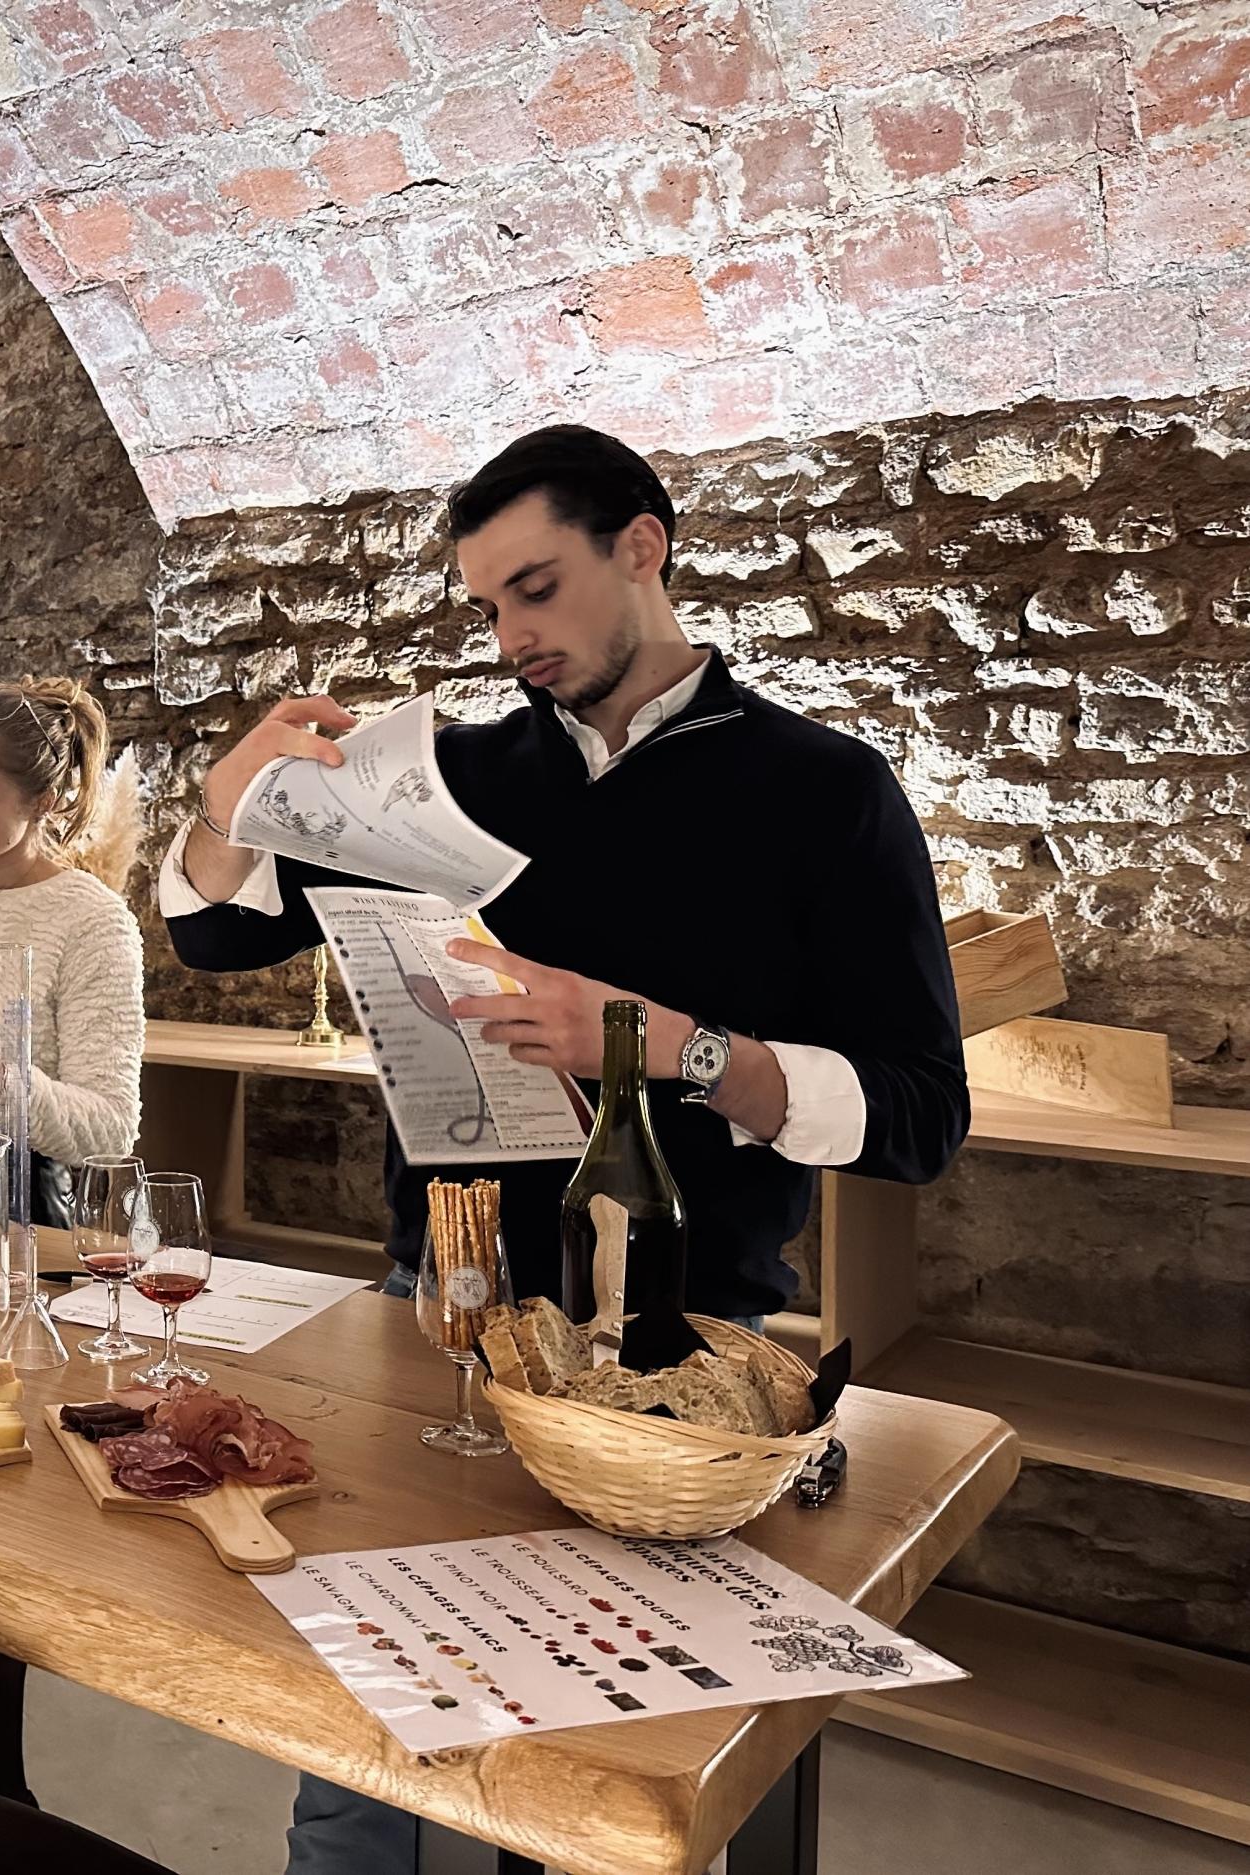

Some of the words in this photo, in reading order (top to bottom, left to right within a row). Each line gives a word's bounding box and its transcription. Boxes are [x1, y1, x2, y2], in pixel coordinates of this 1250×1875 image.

[302, 1565, 320, 1575] LE
[314, 1576, 366, 1619] SAVAGNIN
[345, 1561, 363, 1570] LE
[359, 1572, 431, 1629] CHARDONNAY
[430, 1552, 448, 1562] LE
[443, 1564, 480, 1588] PINOT
[476, 1590, 508, 1611] NOIR
[471, 1548, 490, 1558] LE
[486, 1559, 555, 1607] TROUSSEAU
[512, 1543, 531, 1553] LE
[526, 1554, 589, 1596] POULSARD
[552, 1538, 578, 1552] LES
[576, 1553, 635, 1593] CÉPAGES
[632, 1594, 691, 1632] ROUGES
[700, 1551, 787, 1600] arômes
[725, 1585, 772, 1611] des
[388, 1557, 411, 1572] LES
[408, 1574, 461, 1614] CÉPAGES
[457, 1616, 508, 1653] BLANCS
